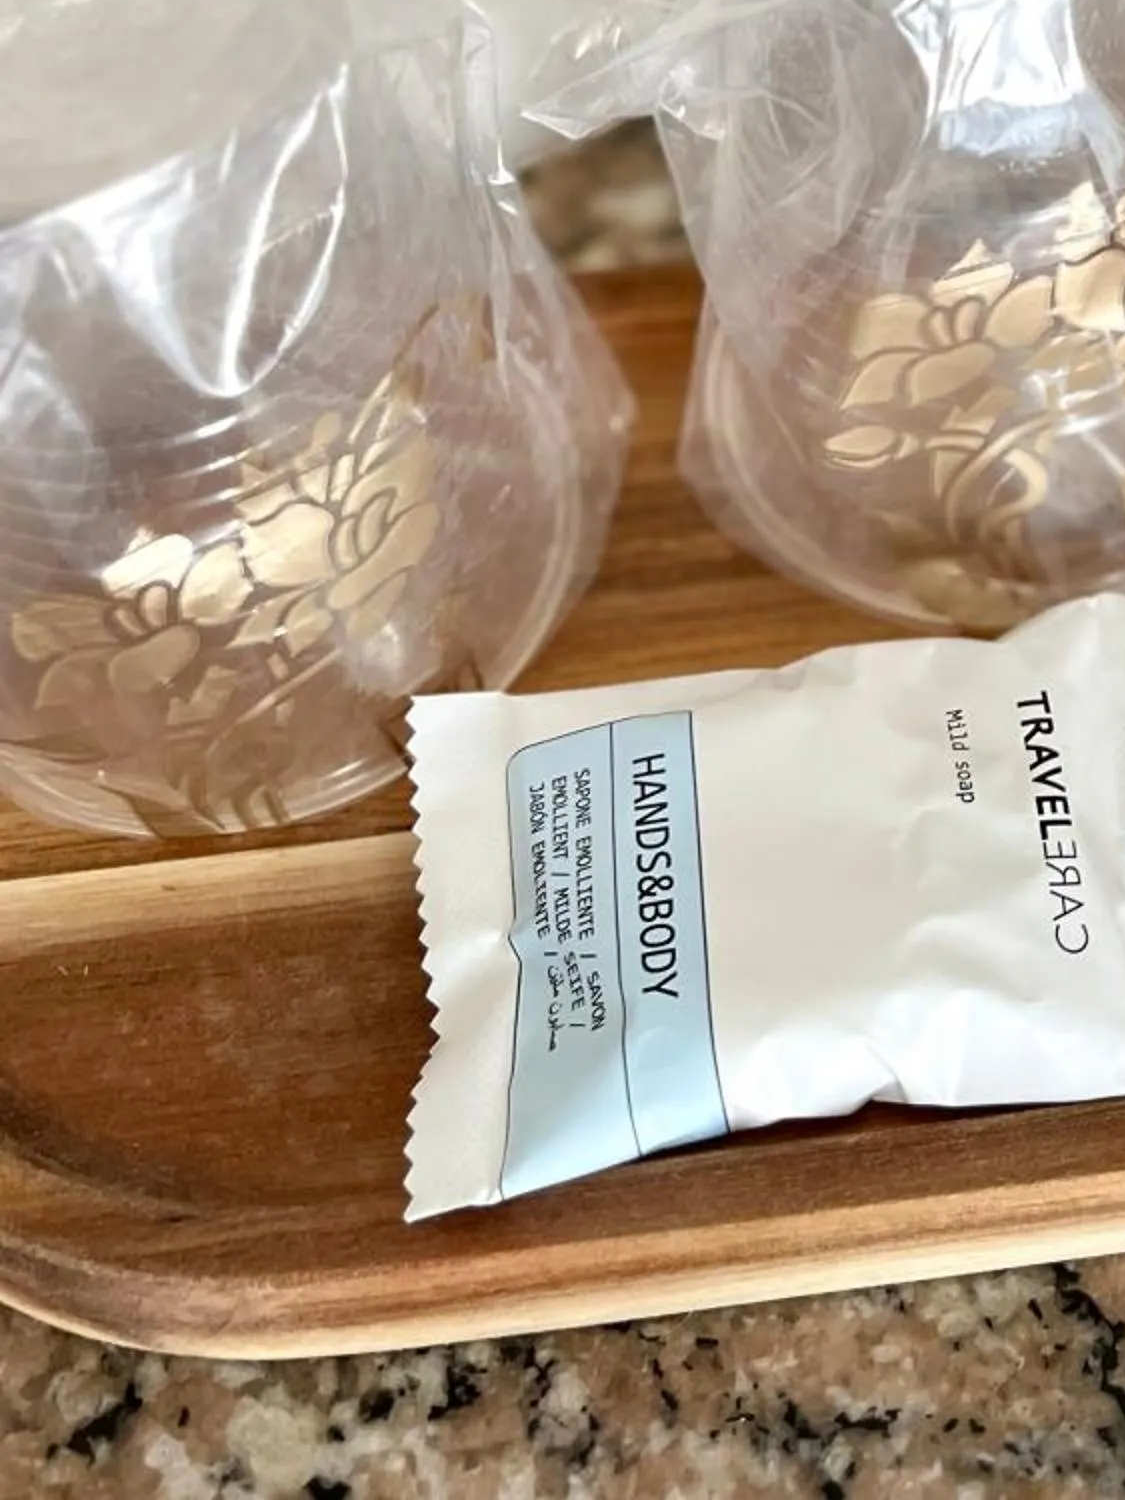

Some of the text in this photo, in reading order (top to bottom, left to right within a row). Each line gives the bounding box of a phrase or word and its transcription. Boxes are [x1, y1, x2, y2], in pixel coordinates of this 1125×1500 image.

[946, 708, 975, 804] Mild soap
[529, 781, 548, 835] JABÓN
[551, 775, 569, 859] EMOLLIENT
[574, 767, 592, 828] SAPONE
[531, 840, 551, 940] EMOLIENTE
[575, 835, 595, 941] EMOLLIENTE
[631, 752, 680, 998] HANDS&BODY
[554, 887, 572, 944] MILDE
[564, 951, 585, 1011] SEIFE
[587, 971, 607, 1031] SAVON
